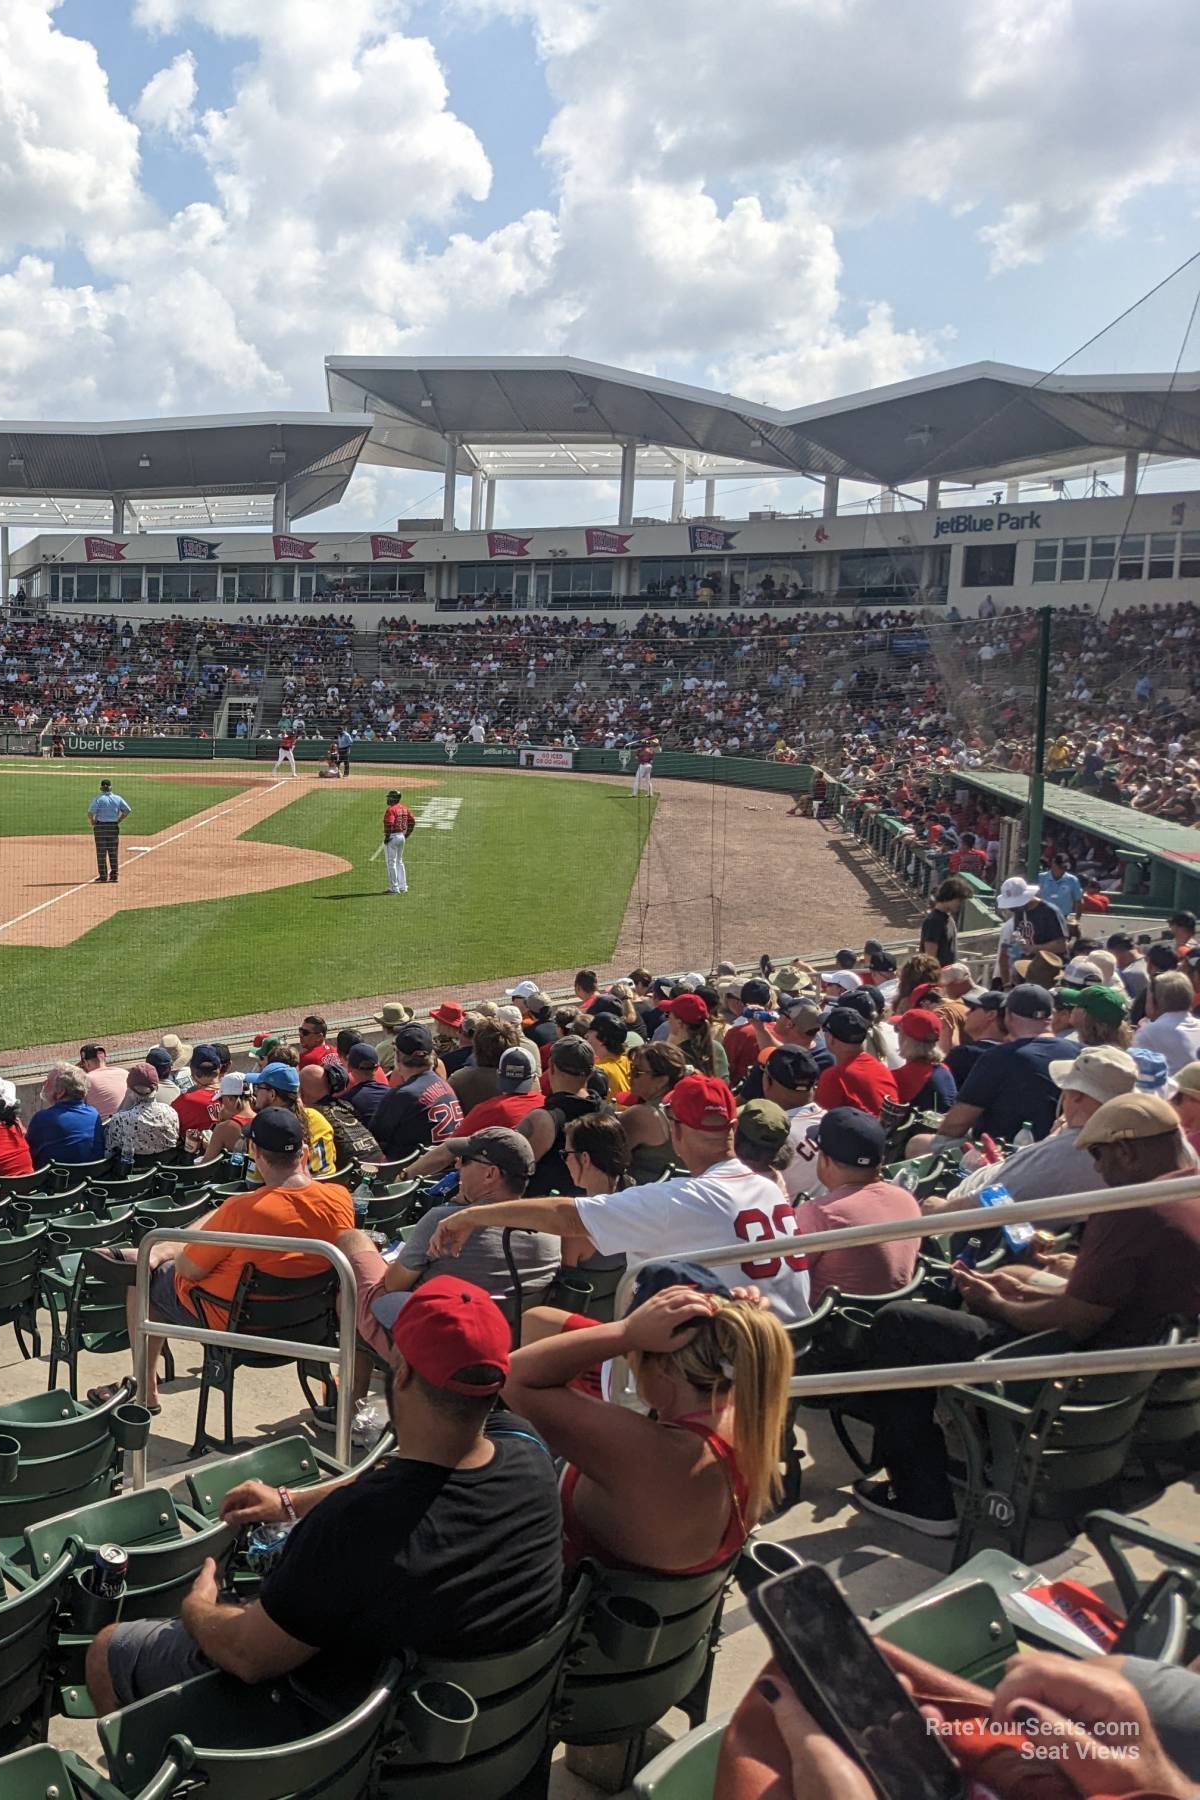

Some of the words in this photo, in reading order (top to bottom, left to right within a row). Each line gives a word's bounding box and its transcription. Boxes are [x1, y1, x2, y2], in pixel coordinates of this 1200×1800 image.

[933, 514, 993, 538] jetBlue
[997, 510, 1041, 530] Park
[68, 737, 125, 752] UberJets
[214, 1365, 221, 1377] 7
[988, 1499, 1009, 1521] 10
